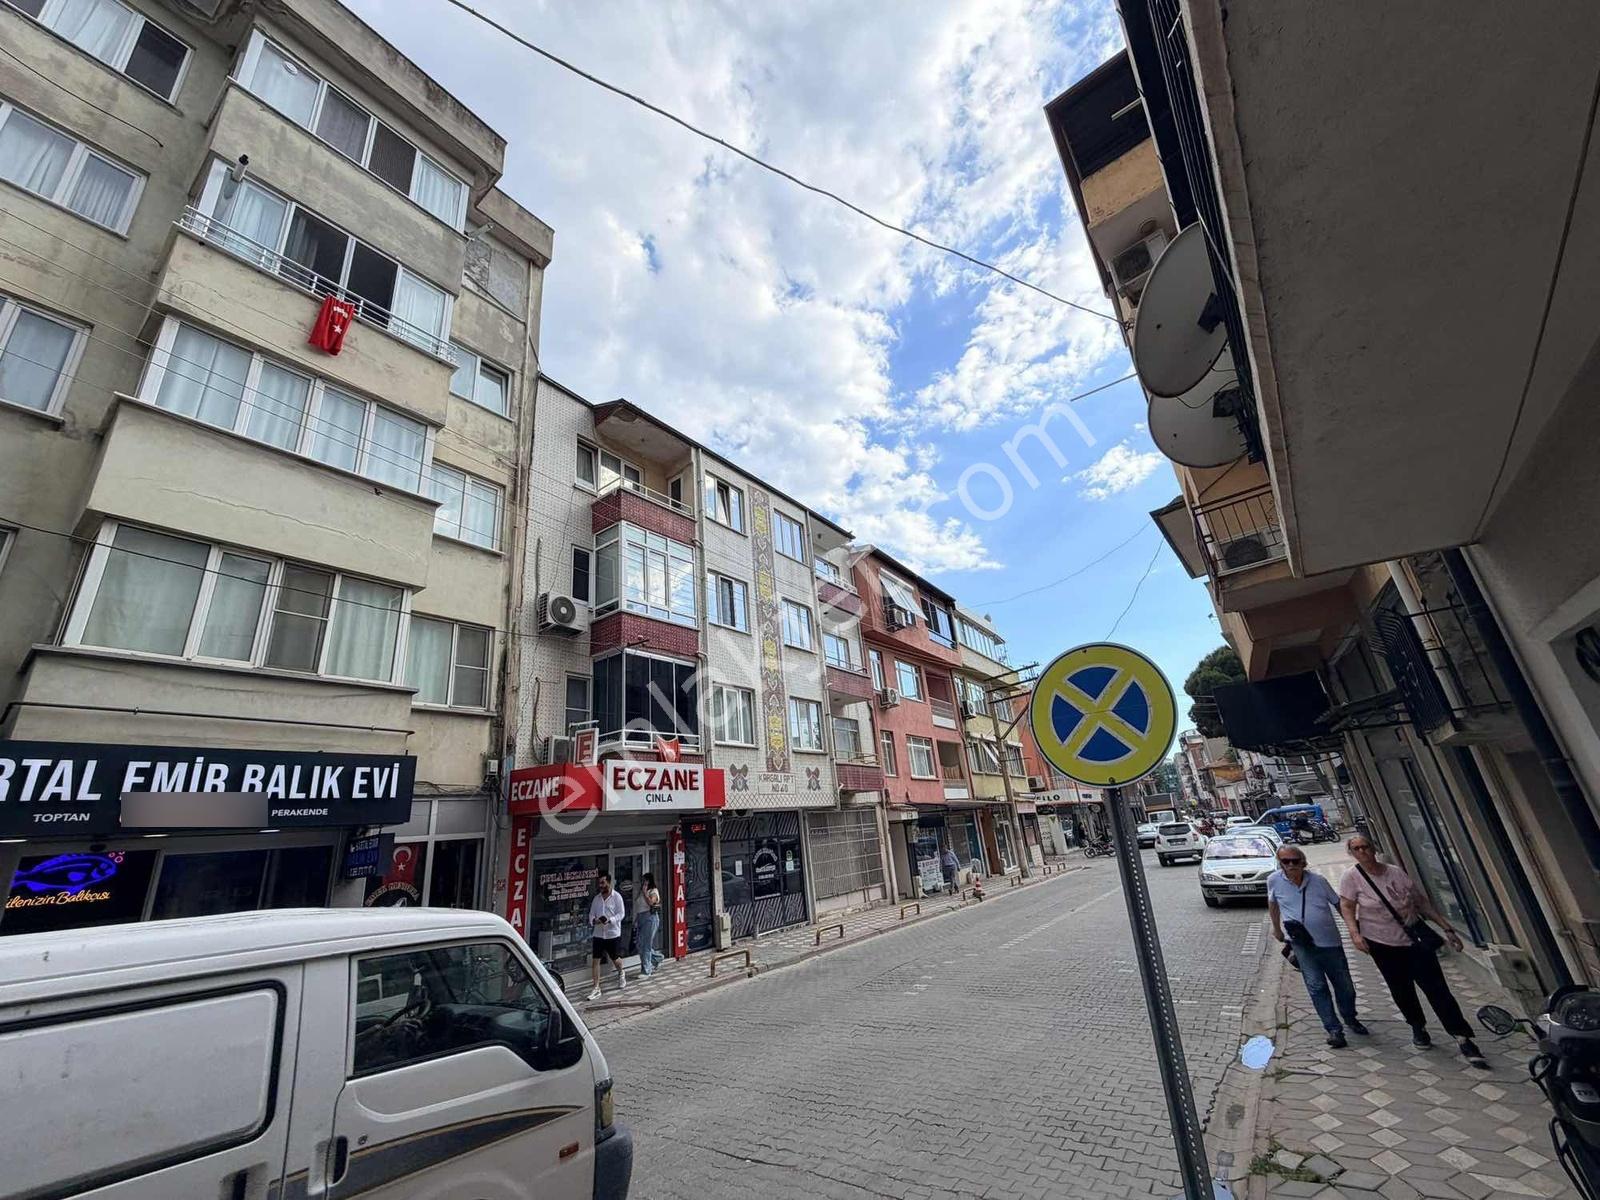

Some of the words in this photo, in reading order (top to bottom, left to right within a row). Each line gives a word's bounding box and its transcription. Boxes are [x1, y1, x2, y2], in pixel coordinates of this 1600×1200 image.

[119, 756, 230, 800] EMİR
[240, 764, 345, 799] BALIK
[352, 762, 400, 799] EVİ
[613, 766, 700, 791] ECZANE
[511, 775, 561, 802] ECZANE
[645, 793, 674, 806] ÇINLA
[33, 812, 91, 823] TOPTAN
[271, 807, 329, 818] PERAKENDE
